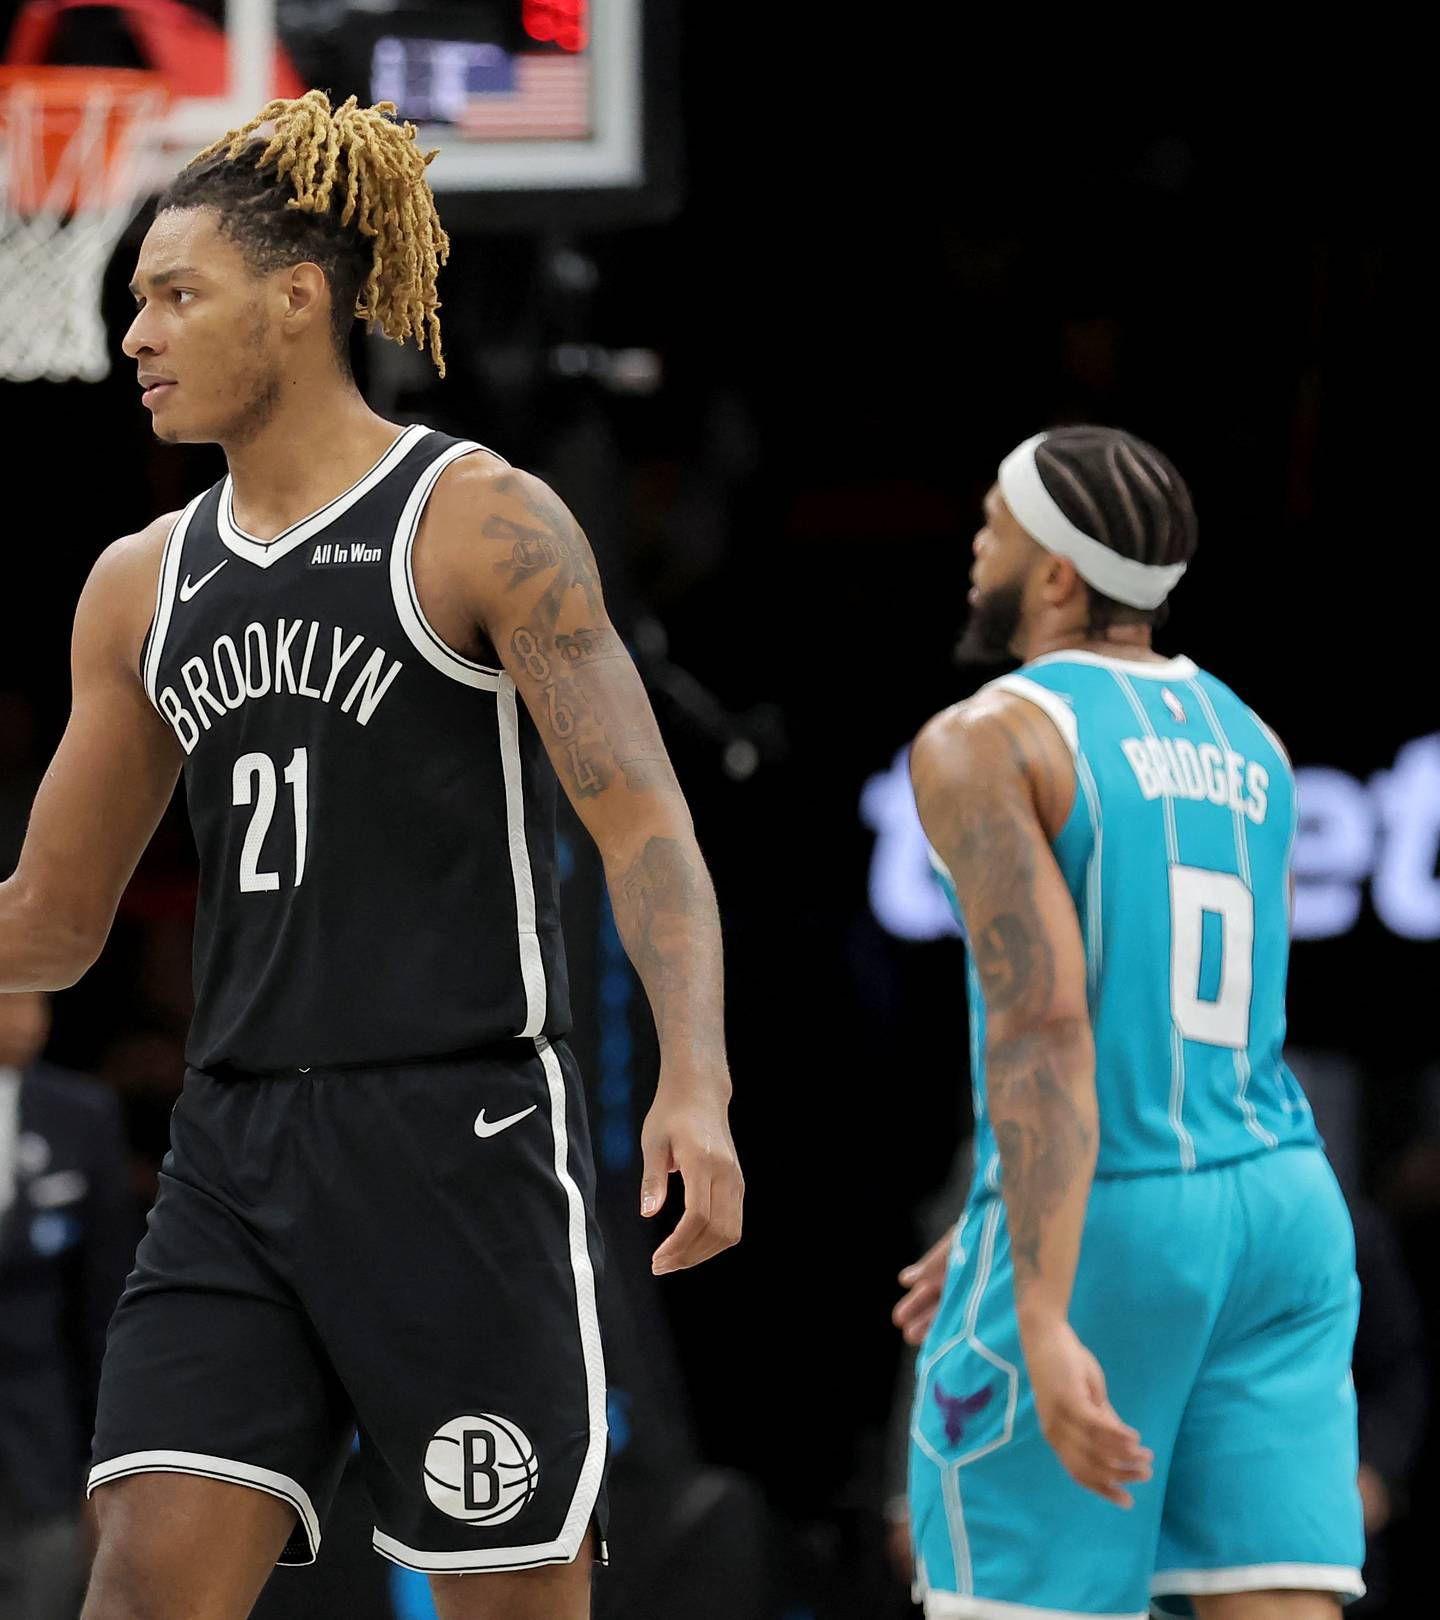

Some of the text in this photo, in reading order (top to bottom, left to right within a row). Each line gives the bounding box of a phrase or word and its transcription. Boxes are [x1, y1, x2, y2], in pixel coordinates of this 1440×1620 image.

[311, 543, 382, 564] All In Won
[160, 618, 404, 756] BROOKLYN
[231, 746, 308, 893] 21
[1120, 736, 1270, 825] BRIDGES
[1168, 862, 1255, 1049] 0
[463, 1429, 500, 1511] B
